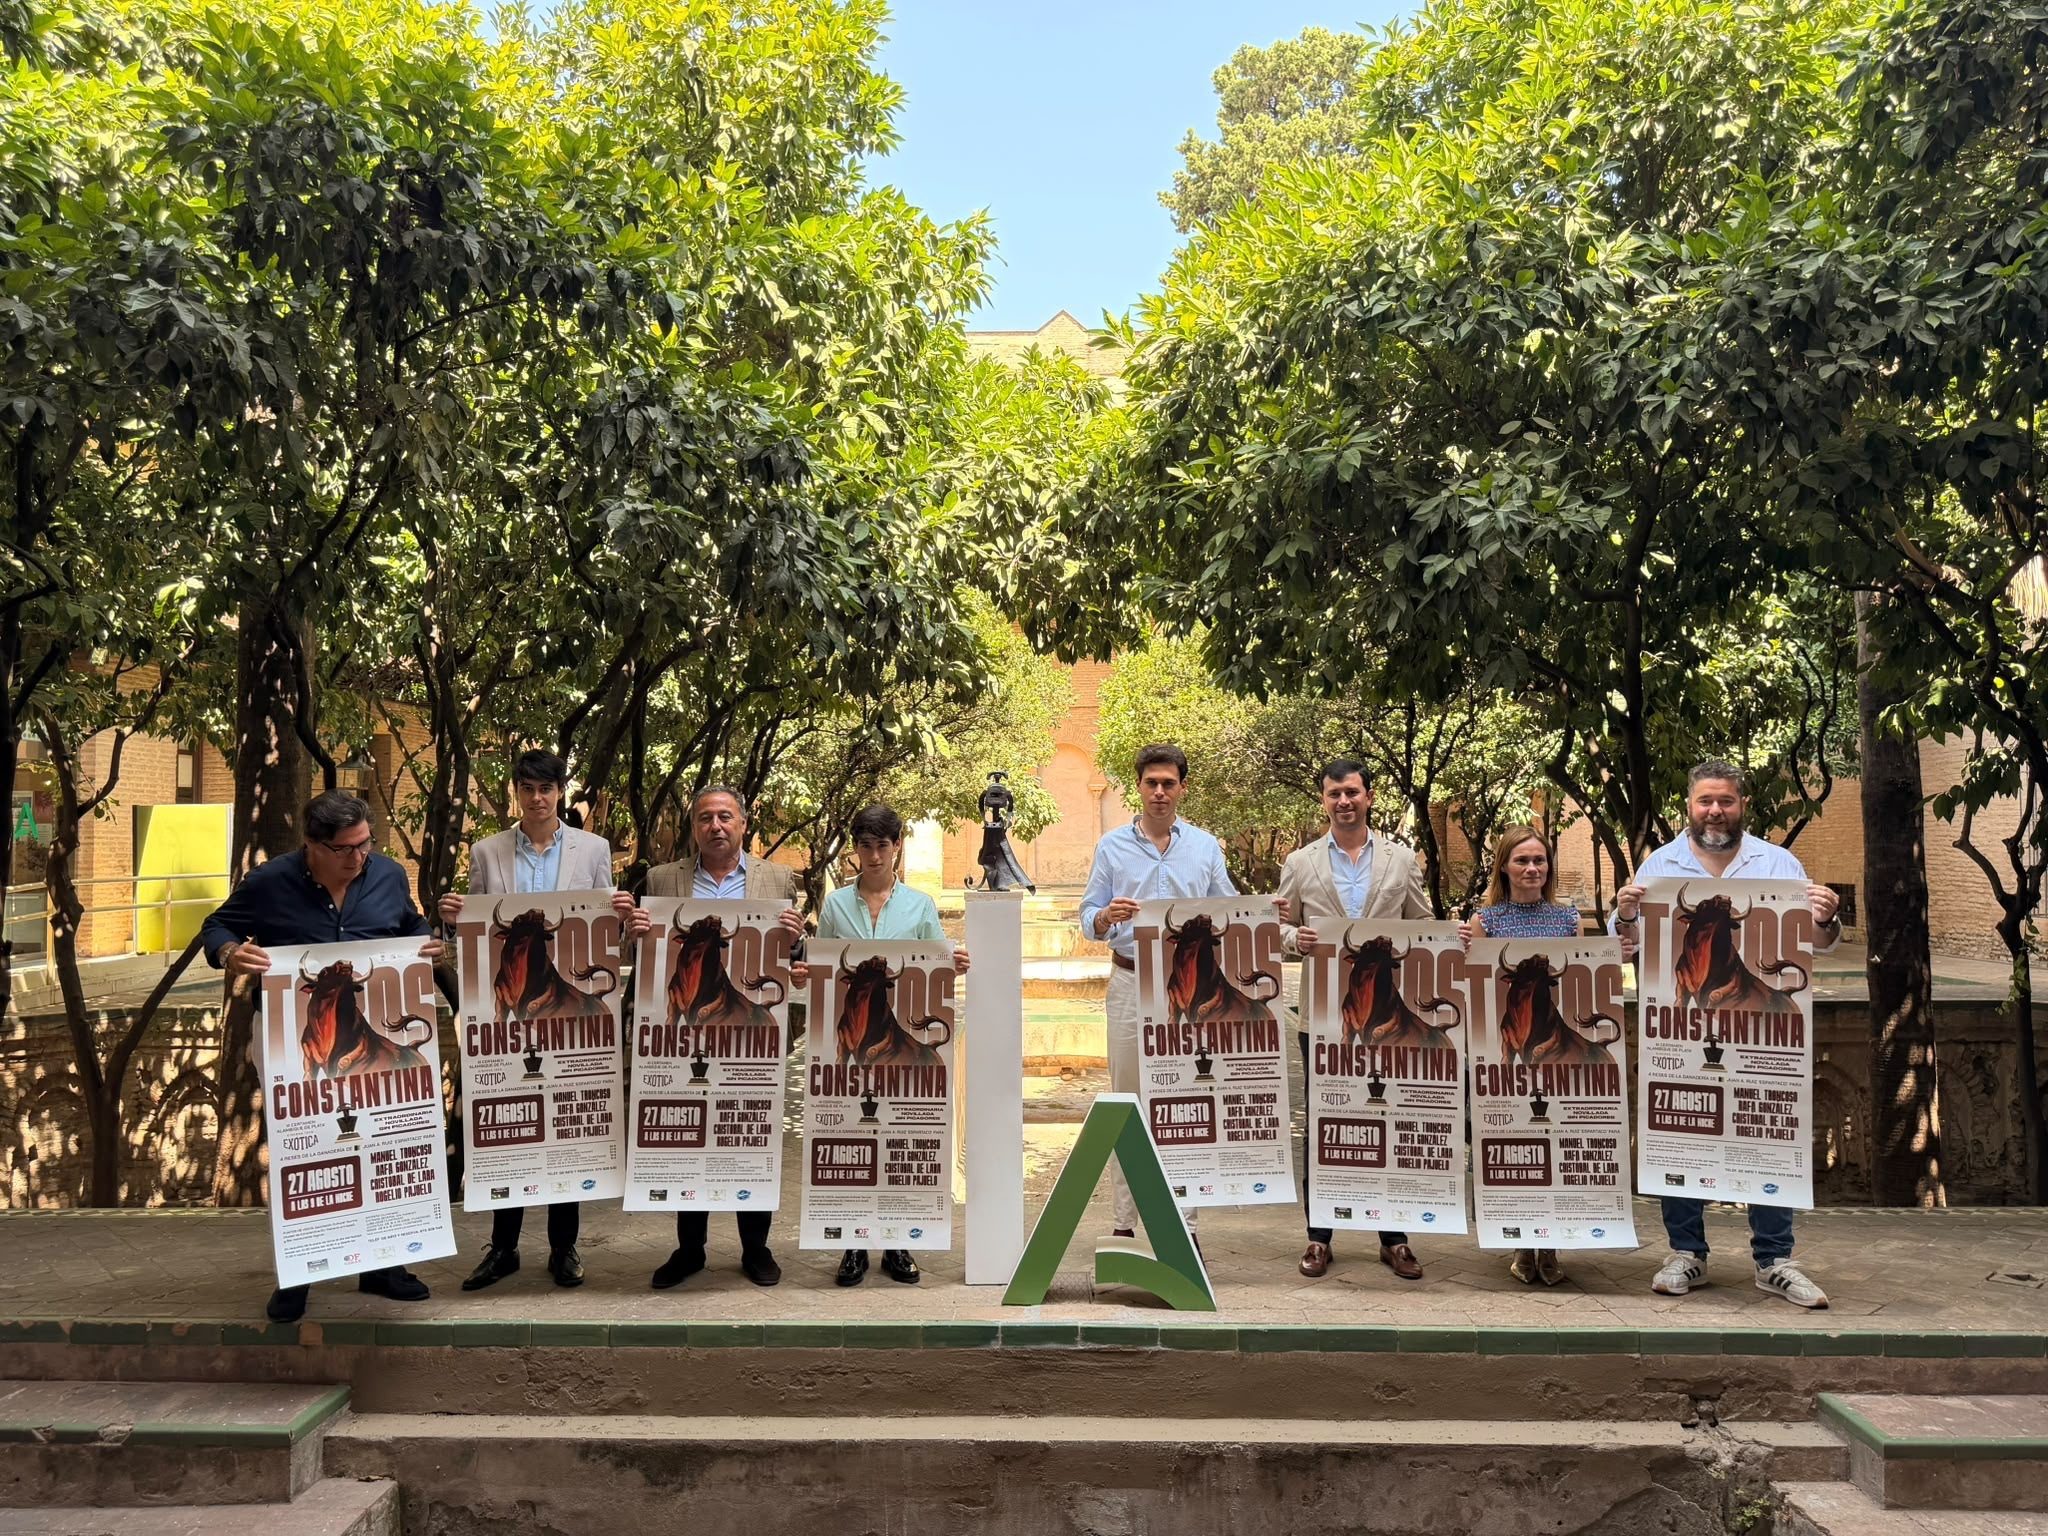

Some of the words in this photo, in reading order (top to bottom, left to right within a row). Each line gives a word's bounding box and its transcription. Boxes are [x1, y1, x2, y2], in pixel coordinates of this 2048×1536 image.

[1638, 901, 1809, 996] TOS
[454, 915, 618, 1010] TOS
[637, 923, 787, 1010] TOS
[1130, 922, 1281, 1011] TOS
[1308, 942, 1462, 1032] TOS
[805, 964, 951, 1050] TOS
[1463, 963, 1622, 1050] TOS
[260, 962, 434, 1070] TOS
[1644, 1004, 1805, 1049] CONSTANTINA
[465, 1012, 616, 1058] CONSTANTINA
[637, 1023, 780, 1059] CONSTANTINA
[1142, 1018, 1281, 1058] CONSTANTINA
[557, 1056, 613, 1065] EXTRAORDINARIA
[1314, 1042, 1458, 1082] CONSTANTINA
[1651, 1056, 1685, 1071] EXOTICA
[1739, 1055, 1802, 1063] EXTRAORDINARIA
[474, 1071, 507, 1086] EXOTICA
[642, 1074, 674, 1088] EXOTICA
[809, 1063, 947, 1098] CONSTANTINA
[1151, 1072, 1181, 1086] EXOTICA
[1474, 1062, 1621, 1097] CONSTANTINA
[272, 1063, 435, 1122] CONSTANTINA
[552, 1090, 579, 1104] MANUEL
[1222, 1094, 1247, 1106] MANUEL
[1321, 1092, 1352, 1106] EXOTICA
[1654, 1088, 1670, 1110] 27
[1671, 1090, 1717, 1113] AGOSTO
[1733, 1086, 1762, 1101] MANUEL
[557, 1103, 574, 1116] RAFA
[575, 1100, 607, 1114] GONZALEZ
[715, 1099, 740, 1111] MANUEL
[1155, 1104, 1169, 1124] 27
[1170, 1102, 1210, 1124] AGOSTO
[1227, 1106, 1243, 1118] RAFA
[1244, 1104, 1274, 1117] GONZALEZ
[1738, 1100, 1756, 1113] RAFA
[1758, 1101, 1793, 1116] GONZALEZ
[373, 1109, 433, 1123] EXTRAORDINARIA
[384, 1115, 423, 1125] NOVILLADA
[478, 1104, 493, 1126] 27
[495, 1101, 538, 1124] AGOSTO
[552, 1114, 585, 1128] CRISTOBAL
[586, 1113, 595, 1125] DE
[596, 1111, 613, 1125] LARA
[643, 1106, 658, 1126] 27
[659, 1106, 701, 1126] AGOSTO
[719, 1111, 735, 1123] RAFA
[737, 1111, 768, 1123] GONZALEZ
[815, 1113, 845, 1127] EXOTICA
[1483, 1113, 1514, 1127] EXOTICA
[1732, 1112, 1768, 1126] CRISTOBAL
[1769, 1115, 1779, 1127] DE
[1781, 1115, 1799, 1129] LARA
[391, 1119, 430, 1129] PICADORES
[713, 1123, 745, 1135] CRISTOBAL
[746, 1123, 755, 1135] DE
[756, 1123, 772, 1135] LARA
[1222, 1117, 1253, 1130] CRISTOBAL
[1254, 1117, 1263, 1129] DE
[1263, 1116, 1280, 1129] LARA
[1394, 1120, 1420, 1133] MANUEL
[556, 1126, 581, 1140] ROGELIO
[582, 1124, 610, 1138] PAJUELO
[1226, 1130, 1251, 1142] ROGELIO
[1251, 1129, 1277, 1141] PAJUELO
[1323, 1124, 1338, 1144] 27
[1339, 1124, 1380, 1146] AGOSTO
[1398, 1132, 1415, 1145] RAFA
[1416, 1133, 1448, 1147] GONZALEZ
[1736, 1125, 1763, 1139] ROGELIO
[1765, 1127, 1795, 1141] PAJUELO
[282, 1134, 319, 1152] EXOTICA
[716, 1135, 741, 1148] ROGELIO
[742, 1135, 768, 1147] PAJUELO
[886, 1138, 910, 1150] MANUEL
[1558, 1137, 1585, 1149] MANUEL
[369, 1149, 398, 1165] MANUEL
[817, 1144, 831, 1165] 27
[832, 1145, 872, 1165] AGOSTO
[889, 1150, 905, 1162] RAFA
[907, 1150, 937, 1162] GONZALEZ
[1393, 1144, 1425, 1158] CRISTOBAL
[1427, 1146, 1435, 1158] DE
[1437, 1146, 1453, 1159] LARA
[1487, 1144, 1501, 1165] 27
[1503, 1145, 1545, 1165] AGOSTO
[1563, 1150, 1580, 1162] RAFA
[1581, 1149, 1613, 1162] GONZALEZ
[375, 1162, 394, 1177] RAFA
[395, 1156, 429, 1174] GONZALEZ
[884, 1162, 915, 1174] CRISTOBAL
[916, 1162, 924, 1174] DE
[926, 1162, 942, 1174] LARA
[1397, 1157, 1422, 1170] ROGELIO
[1423, 1158, 1450, 1171] PAJUELO
[1558, 1162, 1591, 1174] CRISTOBAL
[1592, 1162, 1601, 1174] DE
[1602, 1162, 1620, 1174] LARA
[288, 1171, 304, 1196] 27
[307, 1163, 355, 1192] AGOSTO
[370, 1174, 406, 1191] CRISTOBAL
[407, 1171, 416, 1185] DE
[417, 1168, 436, 1183] LARA
[887, 1174, 911, 1186] ROGELIO
[912, 1174, 938, 1186] PAJUELO
[1562, 1174, 1588, 1186] ROGELIO
[1589, 1174, 1616, 1186] PAJUELO
[375, 1187, 402, 1204] ROGELIO
[403, 1182, 433, 1199] PAJUELO
